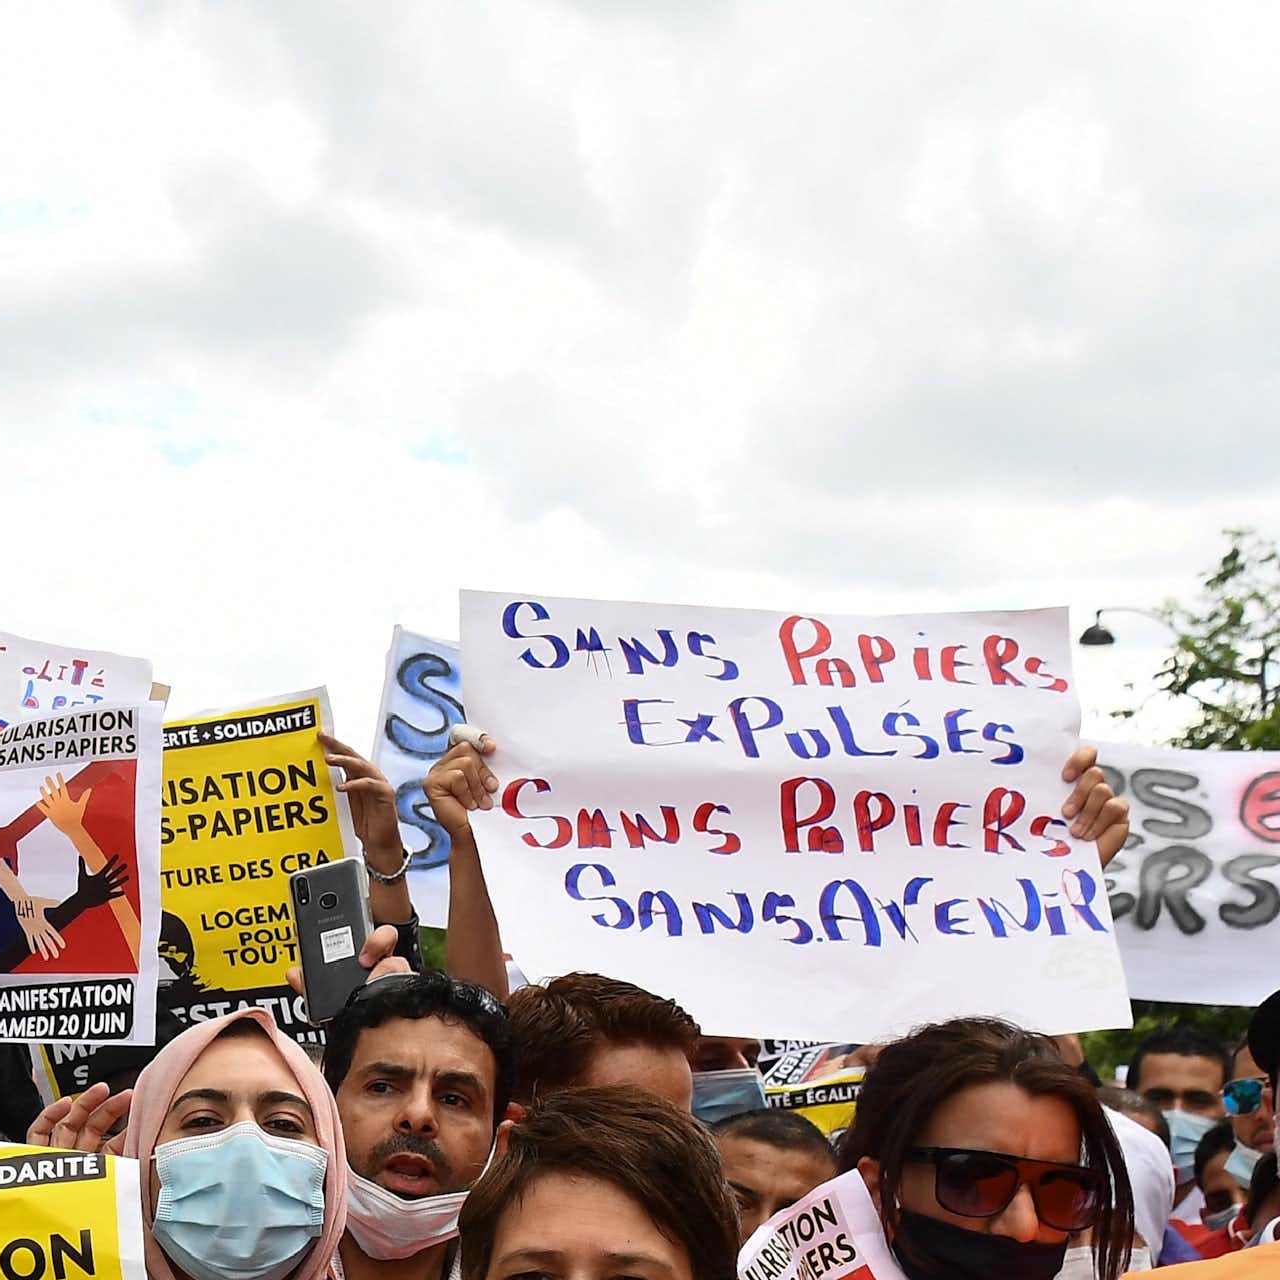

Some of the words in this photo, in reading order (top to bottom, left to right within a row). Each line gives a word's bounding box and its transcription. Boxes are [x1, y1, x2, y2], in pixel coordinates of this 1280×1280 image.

[501, 601, 740, 680] SANS
[213, 707, 313, 742] SOLIDARITÉ
[501, 777, 742, 856] SANS
[228, 858, 272, 883] DES
[57, 1015, 80, 1037] 20
[82, 1011, 126, 1039] JUIN
